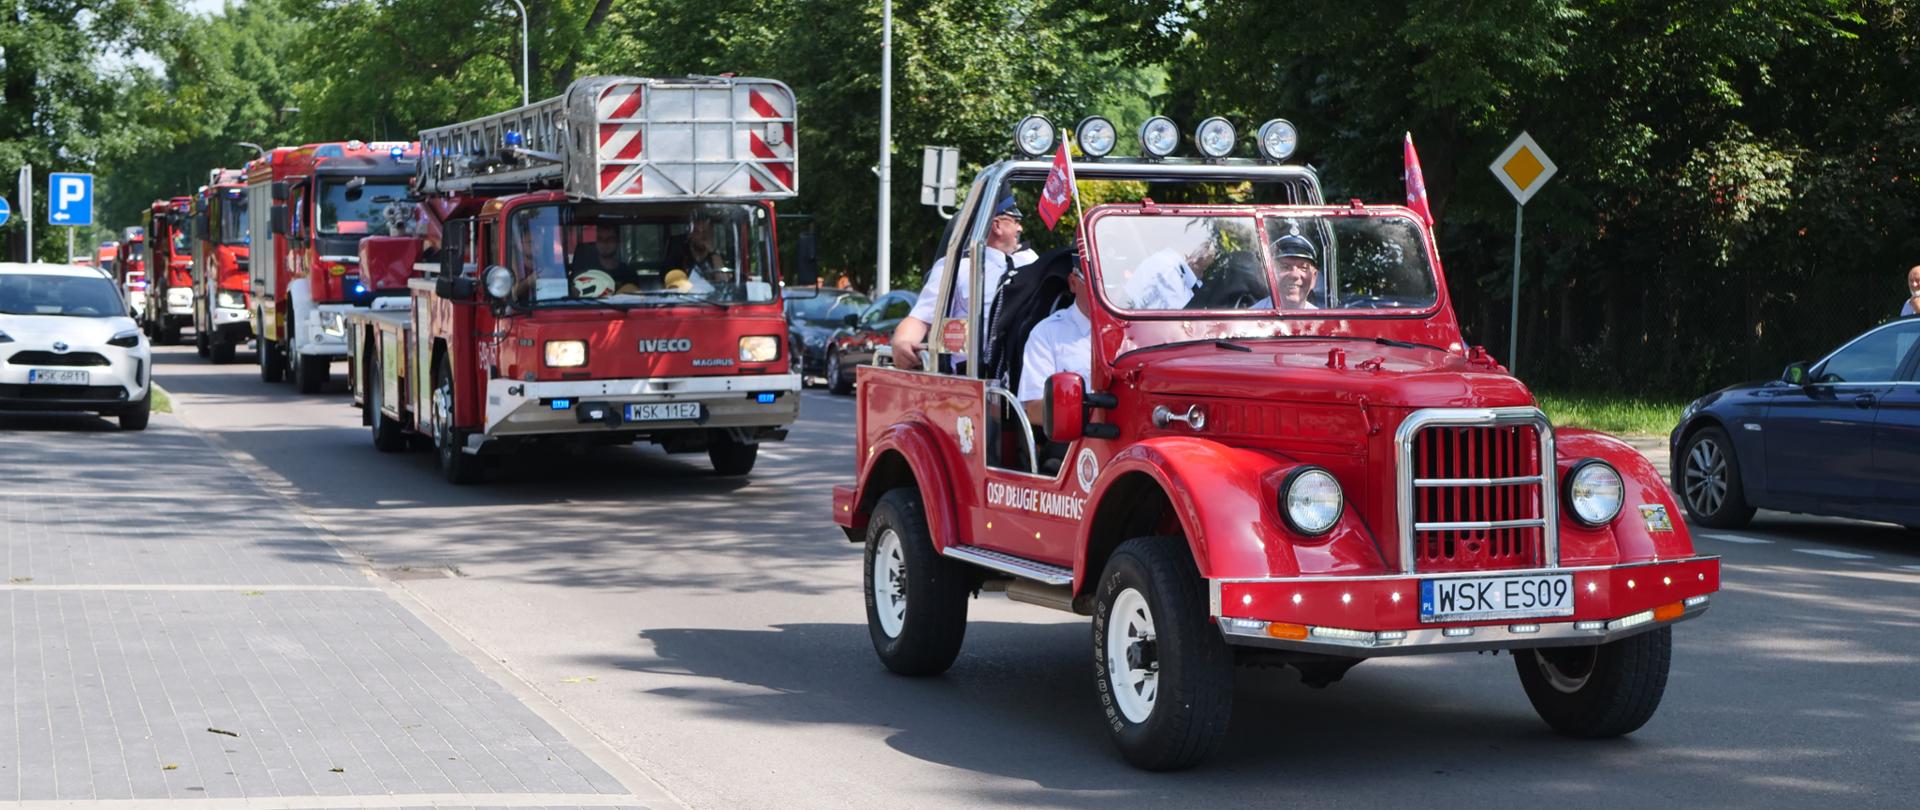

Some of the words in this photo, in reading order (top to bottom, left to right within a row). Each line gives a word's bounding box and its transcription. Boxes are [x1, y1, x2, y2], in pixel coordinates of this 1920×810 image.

[59, 178, 84, 210] P
[638, 338, 692, 353] IVECO
[692, 358, 735, 367] MAGIRUS
[633, 404, 659, 419] WSK
[665, 403, 698, 419] 11E2
[987, 482, 1005, 504] OSP
[1005, 485, 1038, 512] DŁUGIE
[1039, 491, 1088, 520] KAMIEŃS
[1439, 582, 1494, 612] WSK
[1505, 579, 1567, 609] ES09
[1423, 603, 1433, 611] PL
